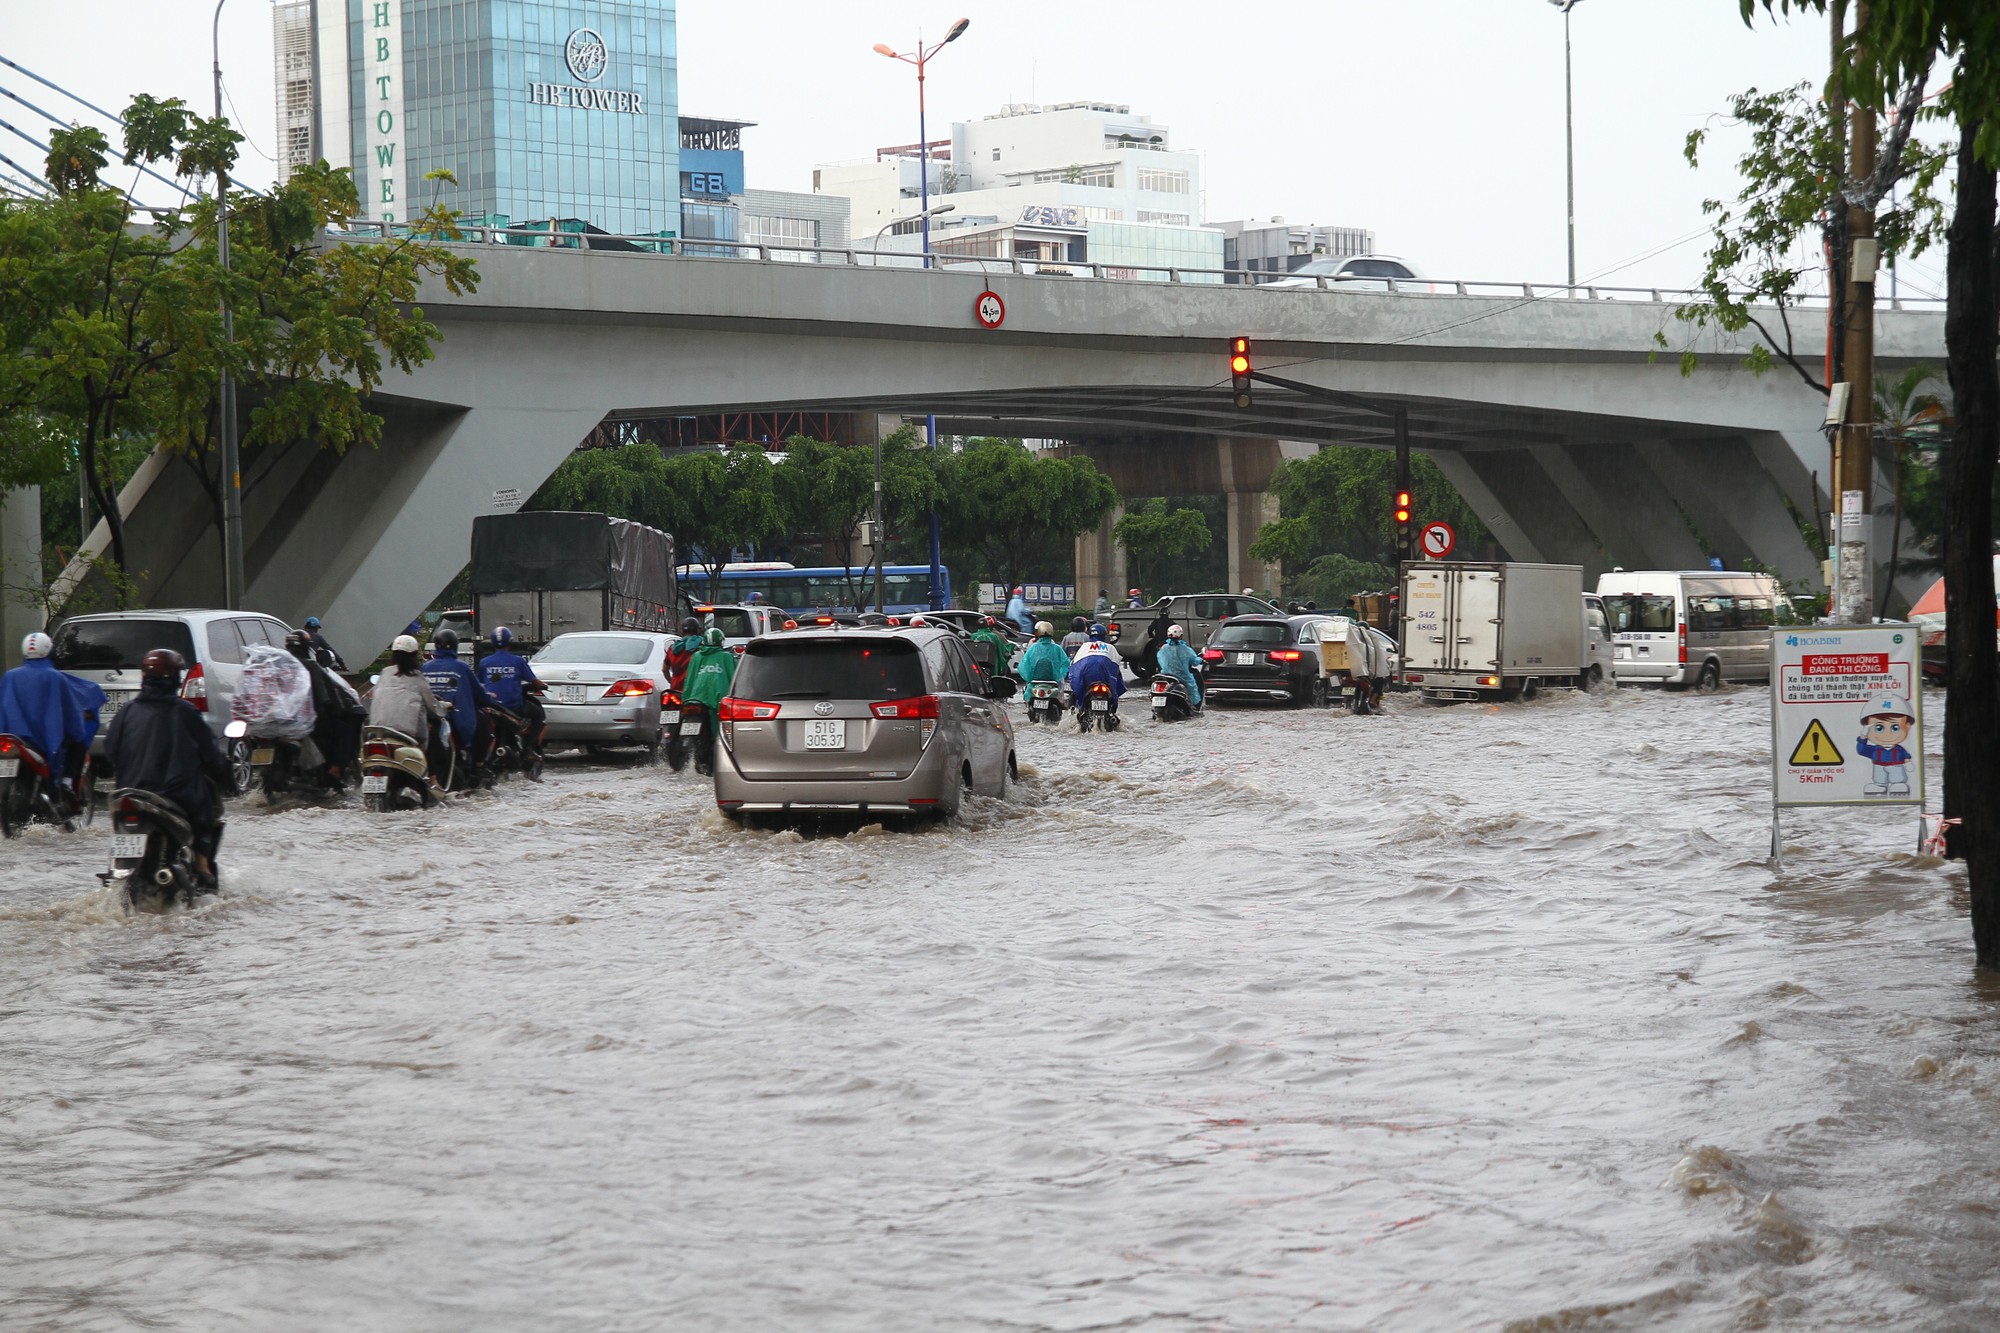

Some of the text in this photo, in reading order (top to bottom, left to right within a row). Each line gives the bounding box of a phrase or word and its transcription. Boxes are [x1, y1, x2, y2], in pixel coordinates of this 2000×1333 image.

[529, 82, 644, 114] HB TOWER
[691, 173, 723, 193] G8
[1811, 656, 1838, 665] CÔNG
[1809, 666, 1835, 674] ĐANG
[1854, 664, 1881, 673] CÔNG
[566, 686, 580, 694] 51A
[1867, 682, 1884, 690] XIN
[815, 722, 835, 733] 51G
[807, 734, 843, 747] 305.37
[1800, 775, 1833, 783] 5Km/h
